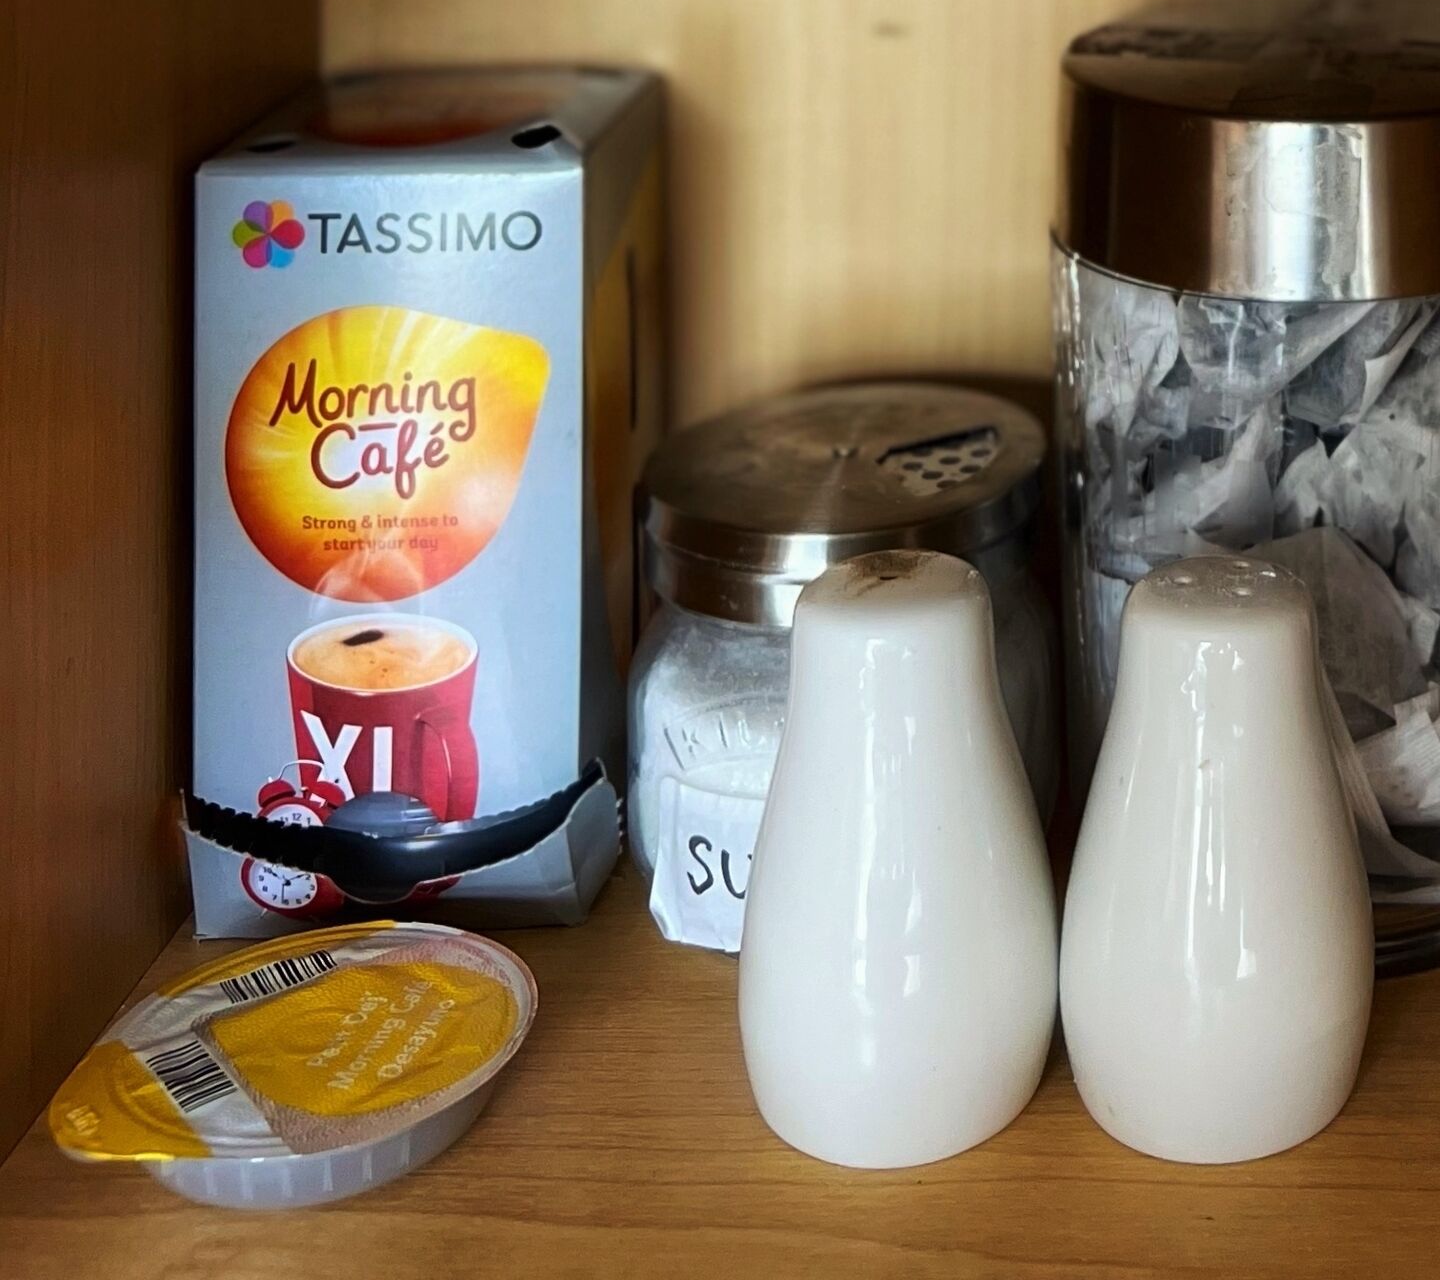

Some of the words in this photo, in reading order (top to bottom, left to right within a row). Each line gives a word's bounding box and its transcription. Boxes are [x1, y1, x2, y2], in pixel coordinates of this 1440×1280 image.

[308, 210, 542, 254] TASSIMO
[269, 359, 476, 442] Morning
[311, 418, 450, 500] Café
[302, 515, 356, 532] Strong
[361, 515, 373, 529] &
[377, 514, 438, 529] intense
[442, 513, 458, 527] to
[324, 537, 363, 551] start
[367, 539, 405, 553] your
[409, 537, 438, 553] day
[687, 835, 752, 900] SU
[327, 1018, 406, 1089] Morning
